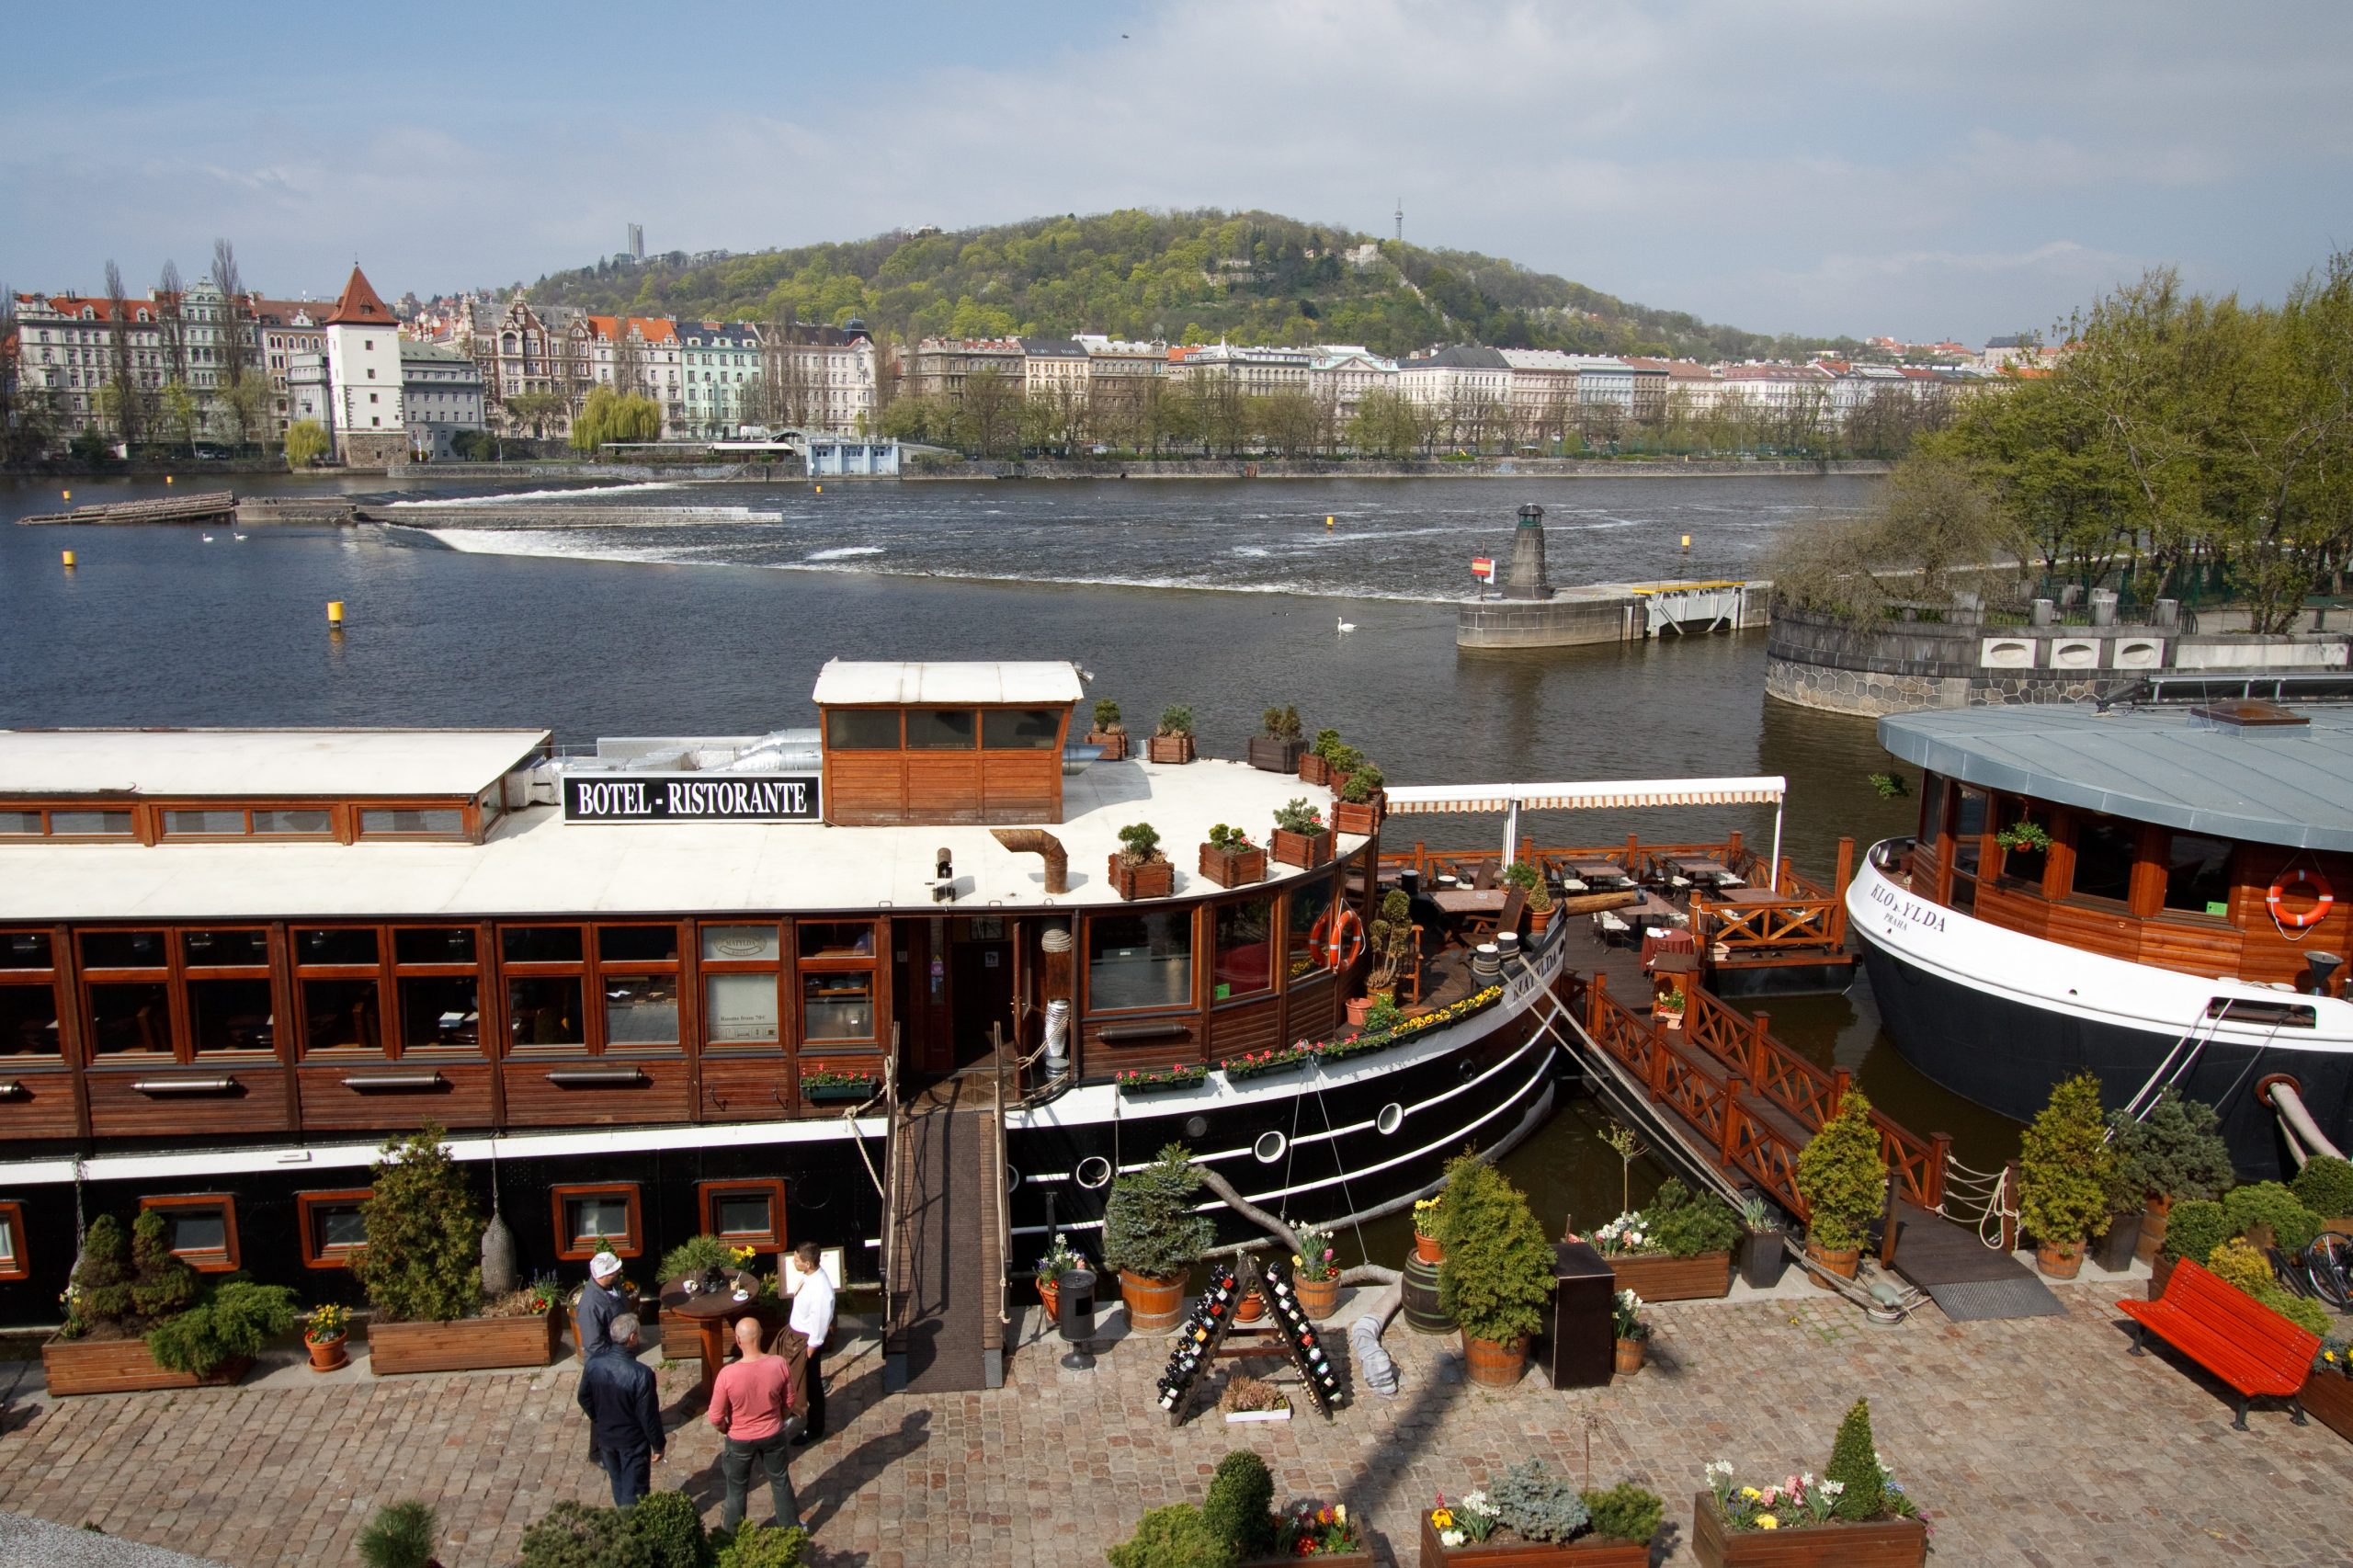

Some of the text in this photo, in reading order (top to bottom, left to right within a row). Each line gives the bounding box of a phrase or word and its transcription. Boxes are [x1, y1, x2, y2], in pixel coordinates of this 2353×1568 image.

[577, 782, 807, 815] BOTEL - RISTORANTE
[1883, 913, 1908, 931] PRAHA
